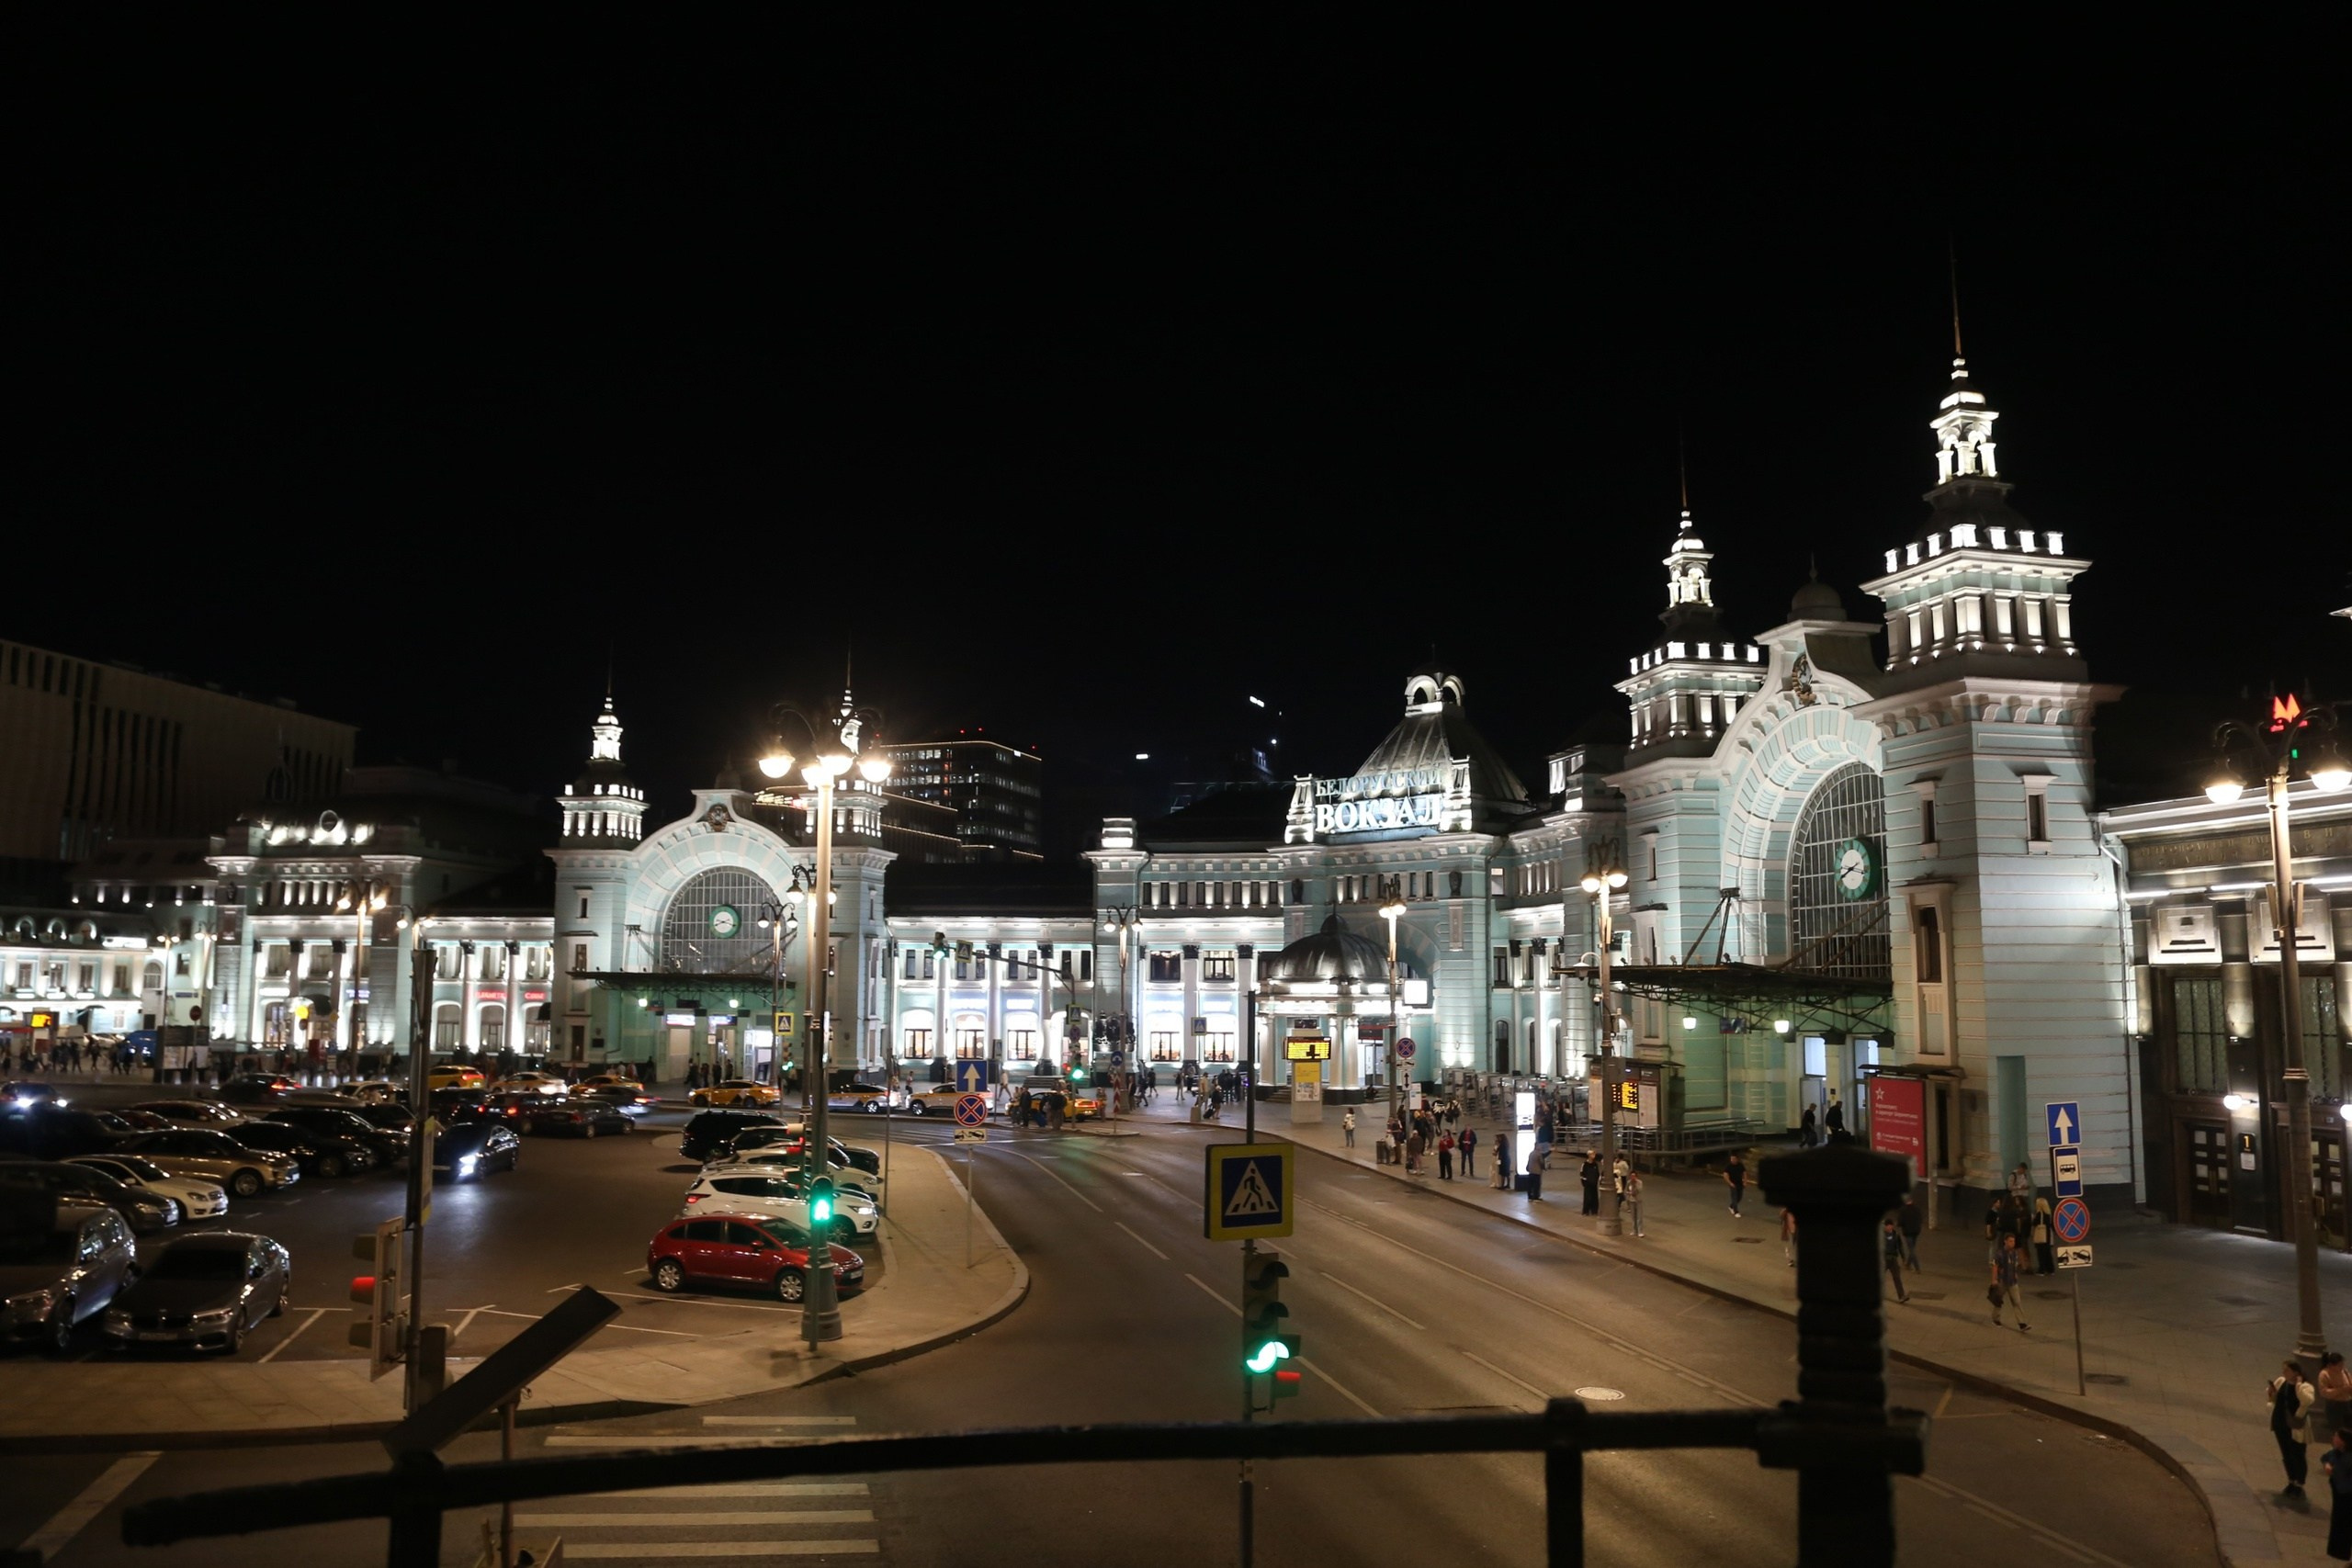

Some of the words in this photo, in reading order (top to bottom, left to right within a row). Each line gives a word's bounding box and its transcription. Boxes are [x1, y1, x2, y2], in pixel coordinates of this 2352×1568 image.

[1316, 770, 1442, 796] БЕЛОРУССКИЙ
[1315, 794, 1442, 833] ВОКЗАЛ
[2244, 1135, 2249, 1148] 1
